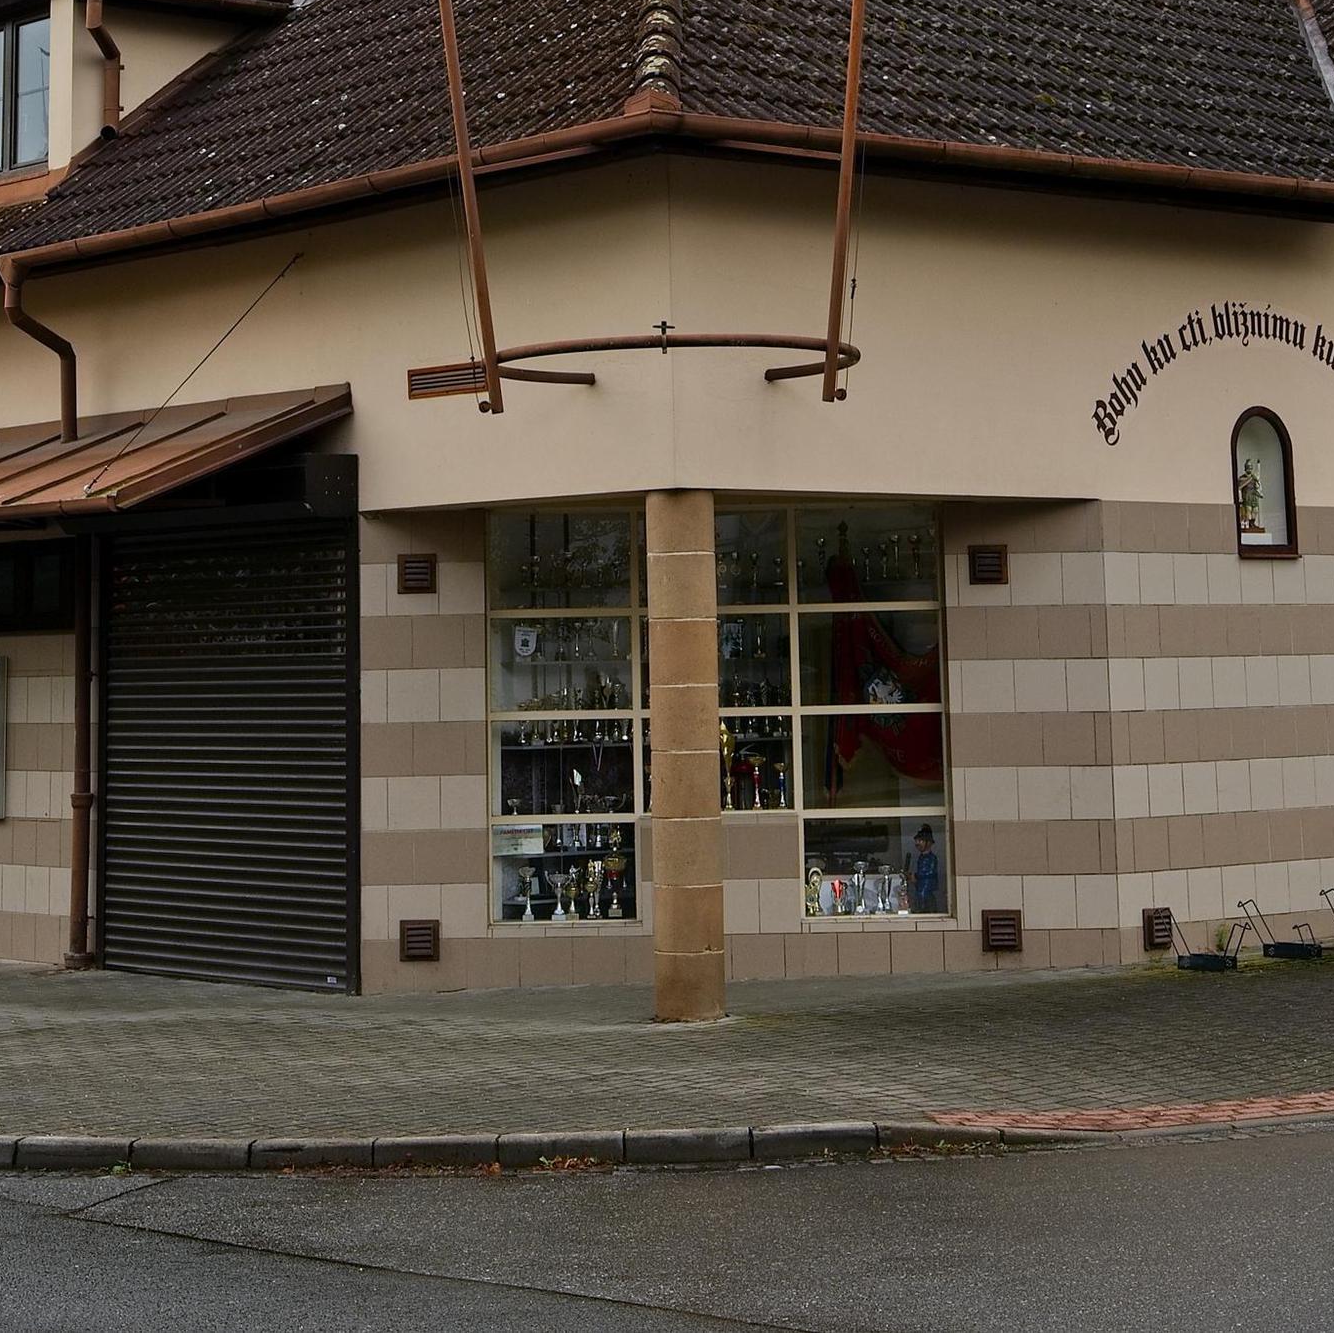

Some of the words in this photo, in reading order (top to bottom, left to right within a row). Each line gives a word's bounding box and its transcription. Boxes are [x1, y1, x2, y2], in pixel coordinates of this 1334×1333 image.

[1091, 362, 1147, 446] Bohu
[1141, 332, 1177, 375] ku
[1211, 300, 1306, 351] bližnímu
